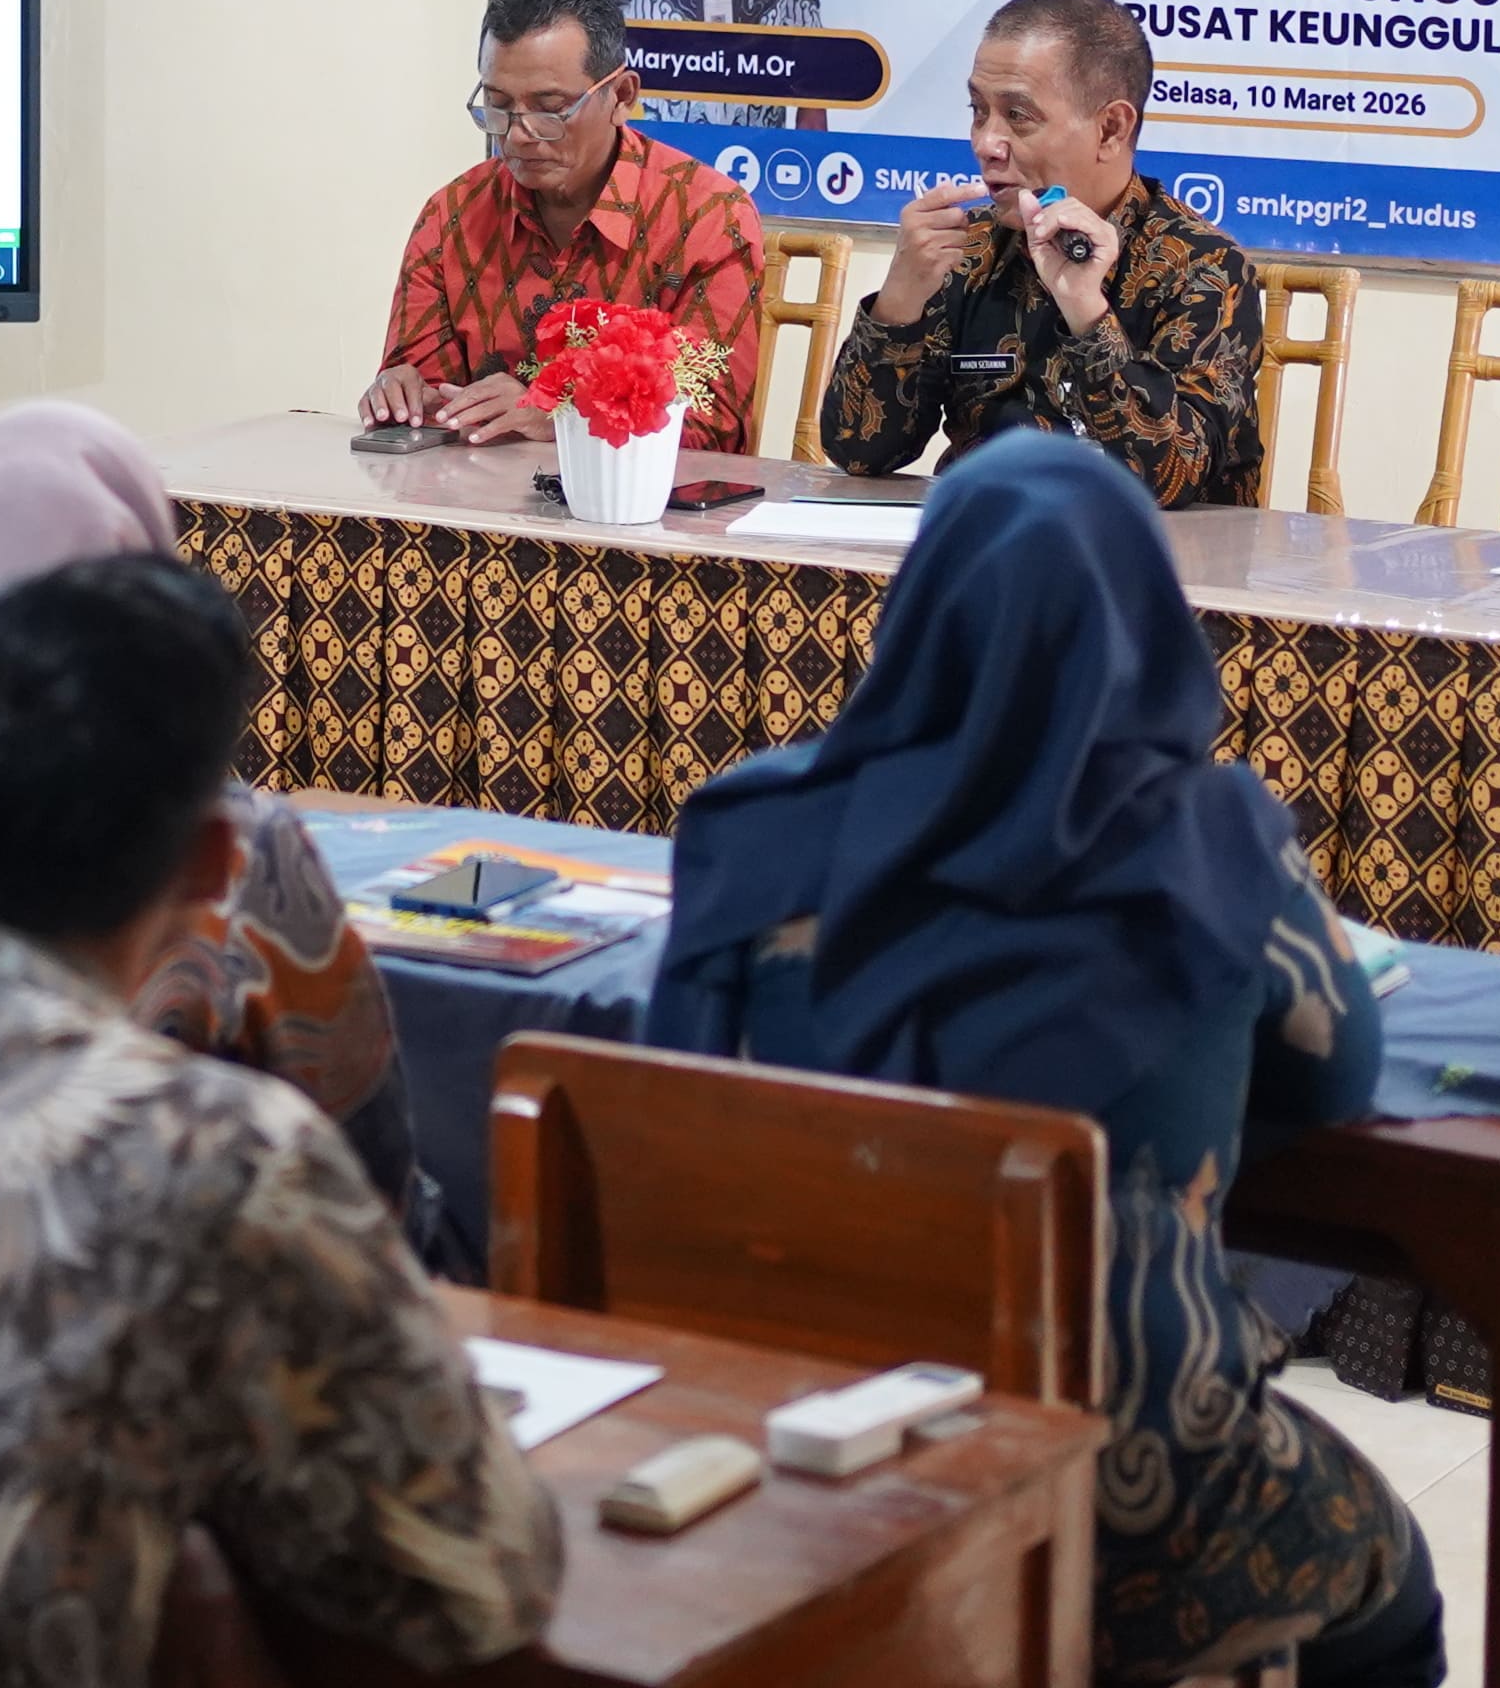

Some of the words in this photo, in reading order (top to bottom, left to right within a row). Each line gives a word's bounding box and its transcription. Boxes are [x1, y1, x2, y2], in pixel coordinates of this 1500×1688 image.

[1126, 2, 1259, 41] PUSAT
[624, 47, 732, 79] Maryadi,
[738, 54, 796, 79] M.Or
[1152, 79, 1239, 110] Selasa,
[1247, 85, 1276, 108] 10
[1284, 87, 1356, 113] Maret
[1362, 90, 1426, 116] 2026
[875, 168, 930, 192] SMK
[1236, 193, 1477, 229] smkpgri2_kudus
